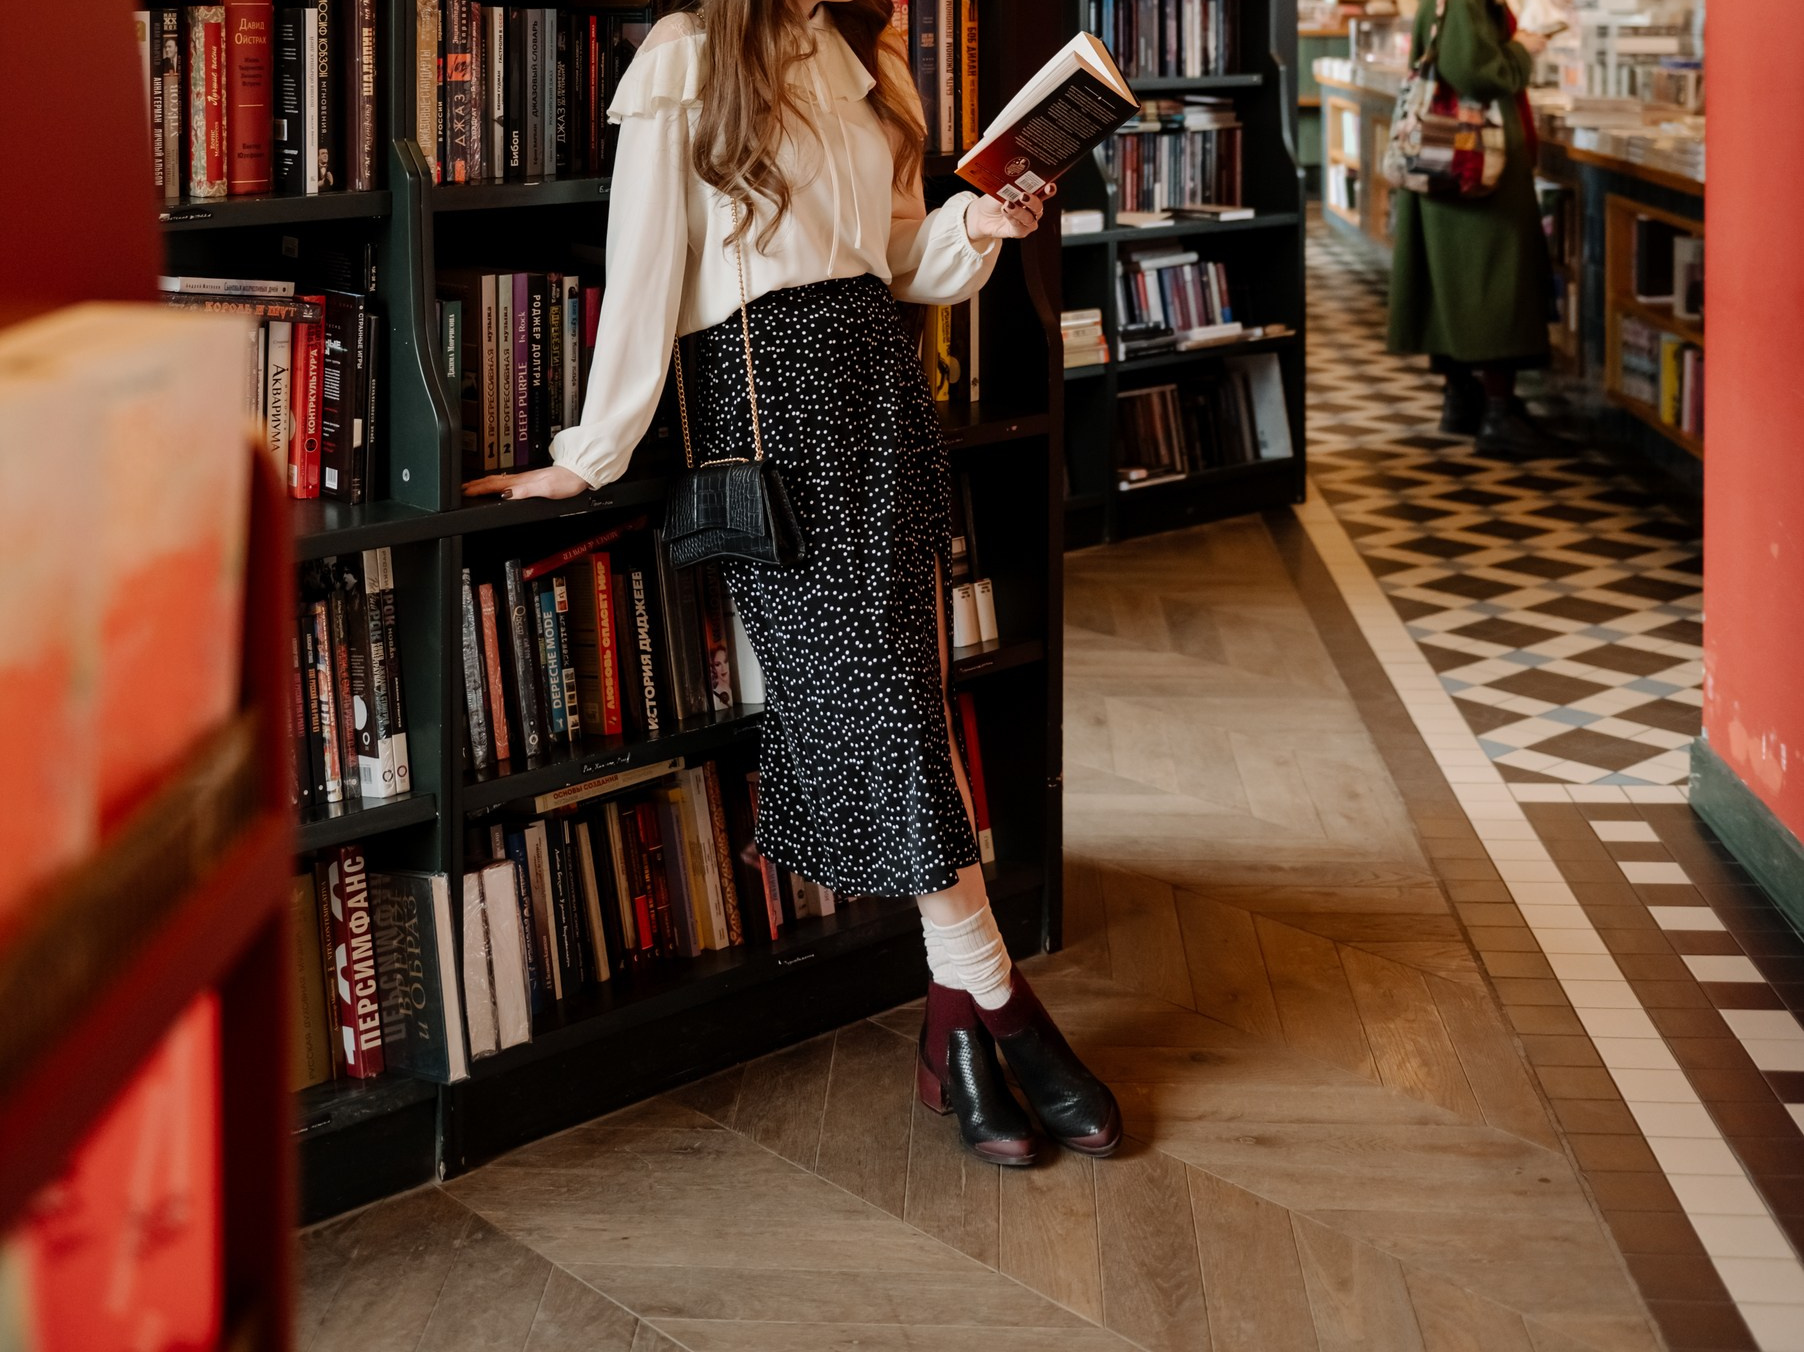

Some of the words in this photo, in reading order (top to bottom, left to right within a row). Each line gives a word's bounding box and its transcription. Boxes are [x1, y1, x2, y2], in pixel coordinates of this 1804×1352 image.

[364, 9, 371, 20] на
[967, 27, 977, 44] БОБ
[318, 38, 329, 78] КОБЗОН
[362, 27, 373, 96] ШАЛЯПИН
[420, 49, 432, 98] СТАНДАРТЫ
[967, 45, 977, 77] ДИЛАН
[153, 77, 162, 95] АННА
[207, 72, 220, 106] Лучшие
[530, 64, 538, 117] ДЖАЗОВЫЙ
[153, 96, 162, 123] ГЕРМАН
[420, 100, 432, 148] ДЖАЗОВЫЕ
[454, 94, 466, 147] ДЖАЗ
[557, 107, 566, 143] ДЖАЗ
[154, 128, 164, 156] ЛИЧНЫЙ
[510, 130, 520, 167] Бибоп
[154, 158, 163, 186] АЛЬБОМ
[204, 301, 252, 314] КОРОЛЬ
[268, 305, 297, 319] ШУТ
[532, 294, 541, 339] РОДЖЕР
[551, 307, 561, 364] ВДРЕБЕЗГИ
[518, 362, 528, 407] PURPLE
[532, 344, 541, 387] ДОЛТРИ
[487, 349, 495, 437] ПРОГРЕССИВНАЯ
[503, 348, 511, 437] ПРОГРЕССИВНАЯ
[518, 410, 528, 441] DEEP
[503, 443, 511, 454] 2
[562, 544, 587, 560] POWER
[597, 562, 608, 591] МИР
[543, 611, 556, 649] MODE
[599, 592, 611, 648] СПАСЕТ
[631, 571, 650, 653] ДИДЖЕЕВ
[547, 652, 563, 709] DEPECHE
[603, 649, 616, 710] ЛЮБОВЬ
[640, 654, 659, 730] ИСТОРИЯ
[553, 787, 584, 800] ОСНОВЫ
[583, 774, 619, 791] СОЗДАНИЯ
[343, 855, 382, 1051] ПЕРСИМФАНС
[402, 894, 426, 1010] ОБРАЗ
